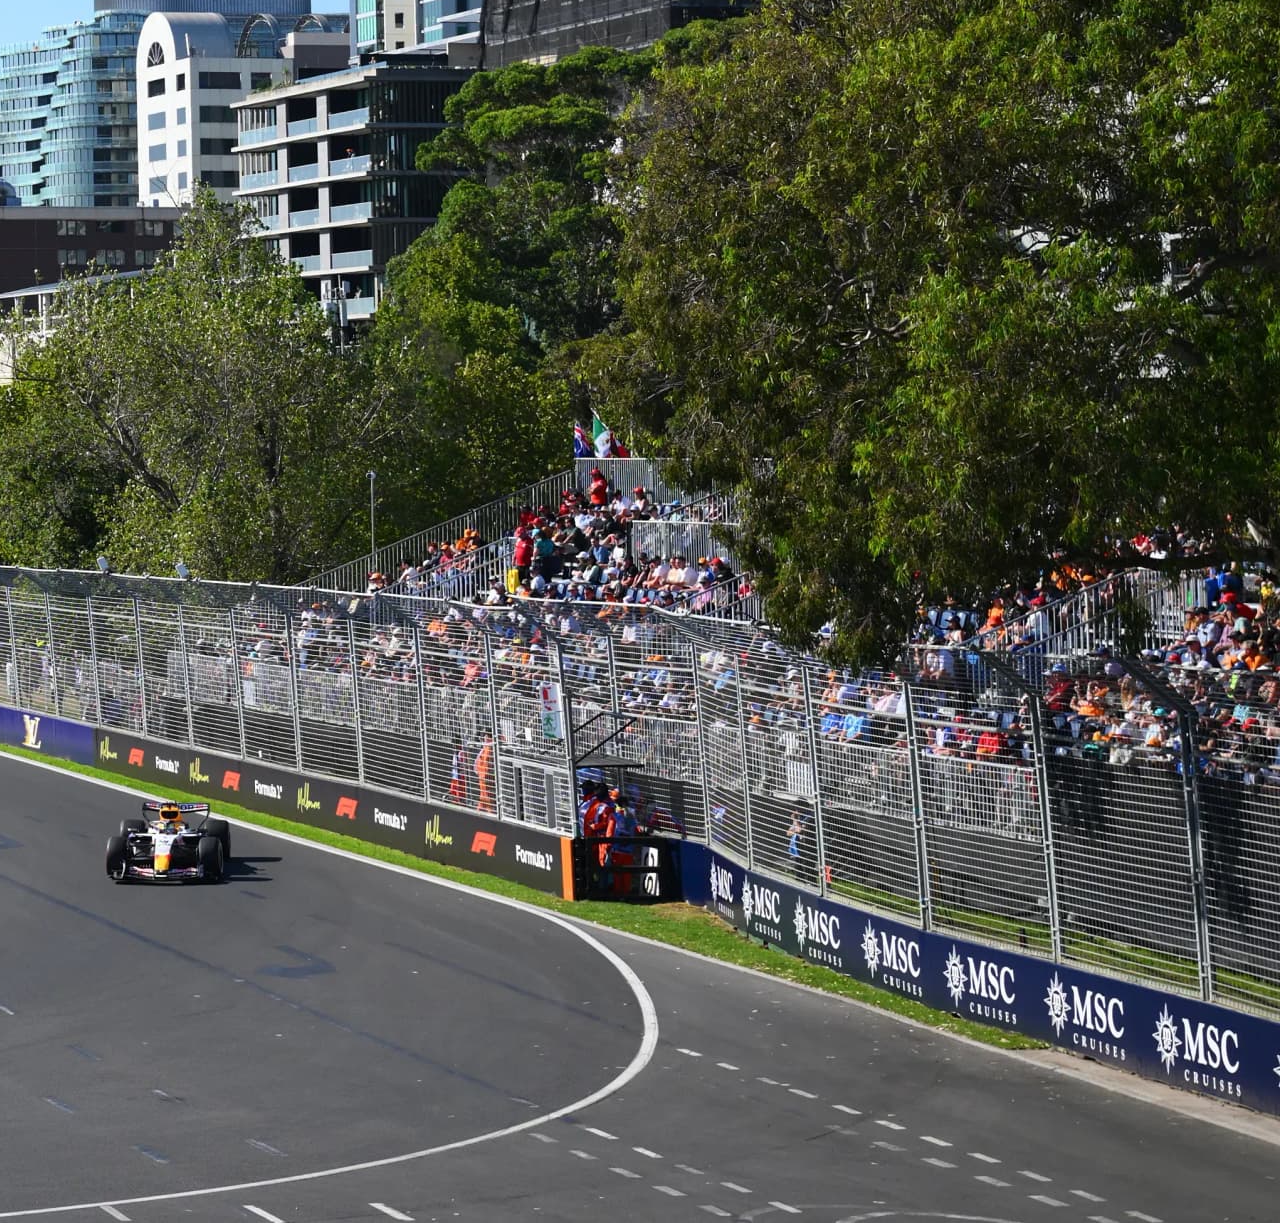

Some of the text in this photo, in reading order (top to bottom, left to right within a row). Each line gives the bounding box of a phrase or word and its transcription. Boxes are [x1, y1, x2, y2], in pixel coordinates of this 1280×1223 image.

[515, 844, 545, 869] Formula
[717, 866, 734, 903] MSC
[753, 884, 781, 924] MSC
[807, 906, 840, 949] MSC
[808, 947, 842, 968] CRUISES
[880, 931, 921, 977] MSC
[883, 973, 923, 998] CRUISES
[967, 957, 1016, 1004] MSC
[969, 1001, 1017, 1025] CRUISES
[1071, 985, 1125, 1038] MSC
[1073, 1032, 1126, 1061] CRUISES
[1182, 1018, 1240, 1073] MSC
[1184, 1069, 1242, 1097] CRUISES
